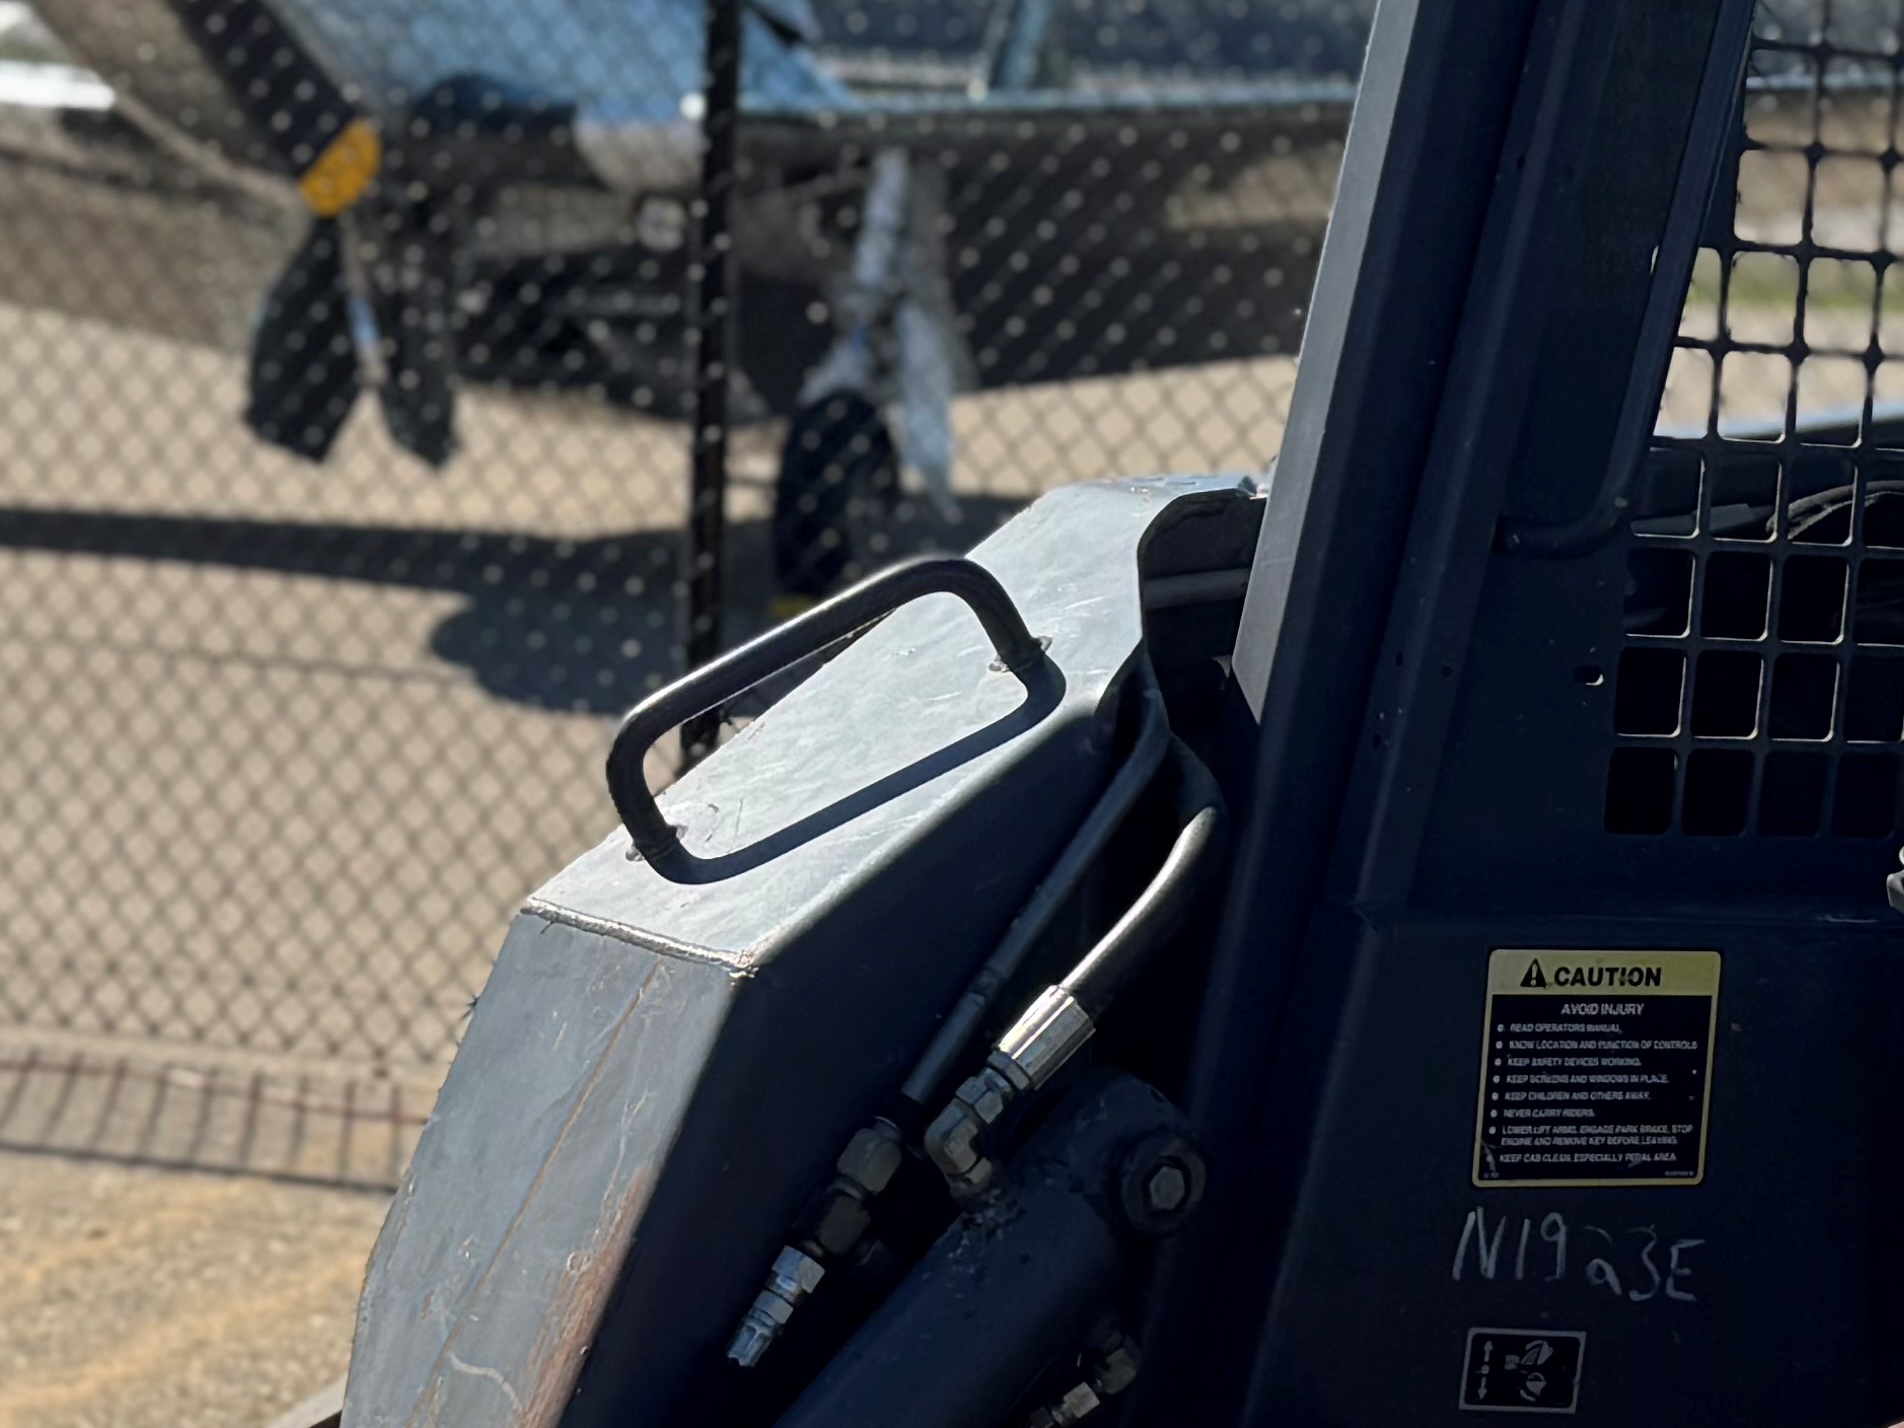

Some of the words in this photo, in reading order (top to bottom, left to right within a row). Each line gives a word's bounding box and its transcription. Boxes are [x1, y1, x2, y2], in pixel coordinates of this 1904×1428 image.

[1554, 966, 1662, 987] CAUTION
[1561, 1003, 1600, 1015] AVOID
[1601, 1003, 1645, 1015] INJURY
[1510, 1023, 1534, 1034] READ
[1509, 1040, 1534, 1050] KNOW
[1536, 1040, 1578, 1050] LOCATION
[1579, 1040, 1597, 1050] AND
[1598, 1040, 1640, 1050] FUNCTION
[1640, 1040, 1652, 1050] OF
[1507, 1057, 1530, 1067] KEEP
[1531, 1057, 1563, 1067] SAFETY
[1506, 1074, 1528, 1084] KEEP
[1570, 1074, 1587, 1084] AND
[1588, 1074, 1629, 1084] WINDOWS
[1630, 1074, 1640, 1084] IN
[1504, 1091, 1527, 1101] KEEP
[1528, 1091, 1570, 1101] CHILDREN
[1571, 1091, 1589, 1101] AND
[1590, 1091, 1624, 1101] OTHERS
[1503, 1108, 1531, 1118] NEVER
[1502, 1125, 1532, 1134] LOWER
[1579, 1125, 1614, 1134] ENGAGE
[1615, 1125, 1639, 1134] PARK
[1501, 1136, 1533, 1146] ENGINE
[1534, 1136, 1552, 1146] AND
[1552, 1136, 1587, 1146] REMOVE
[1588, 1136, 1605, 1146] KEY
[1607, 1136, 1640, 1146] BEFORE
[1499, 1153, 1522, 1163] KEEP
[1523, 1153, 1541, 1163] CAB
[1573, 1153, 1623, 1163] ESPECIALLY
